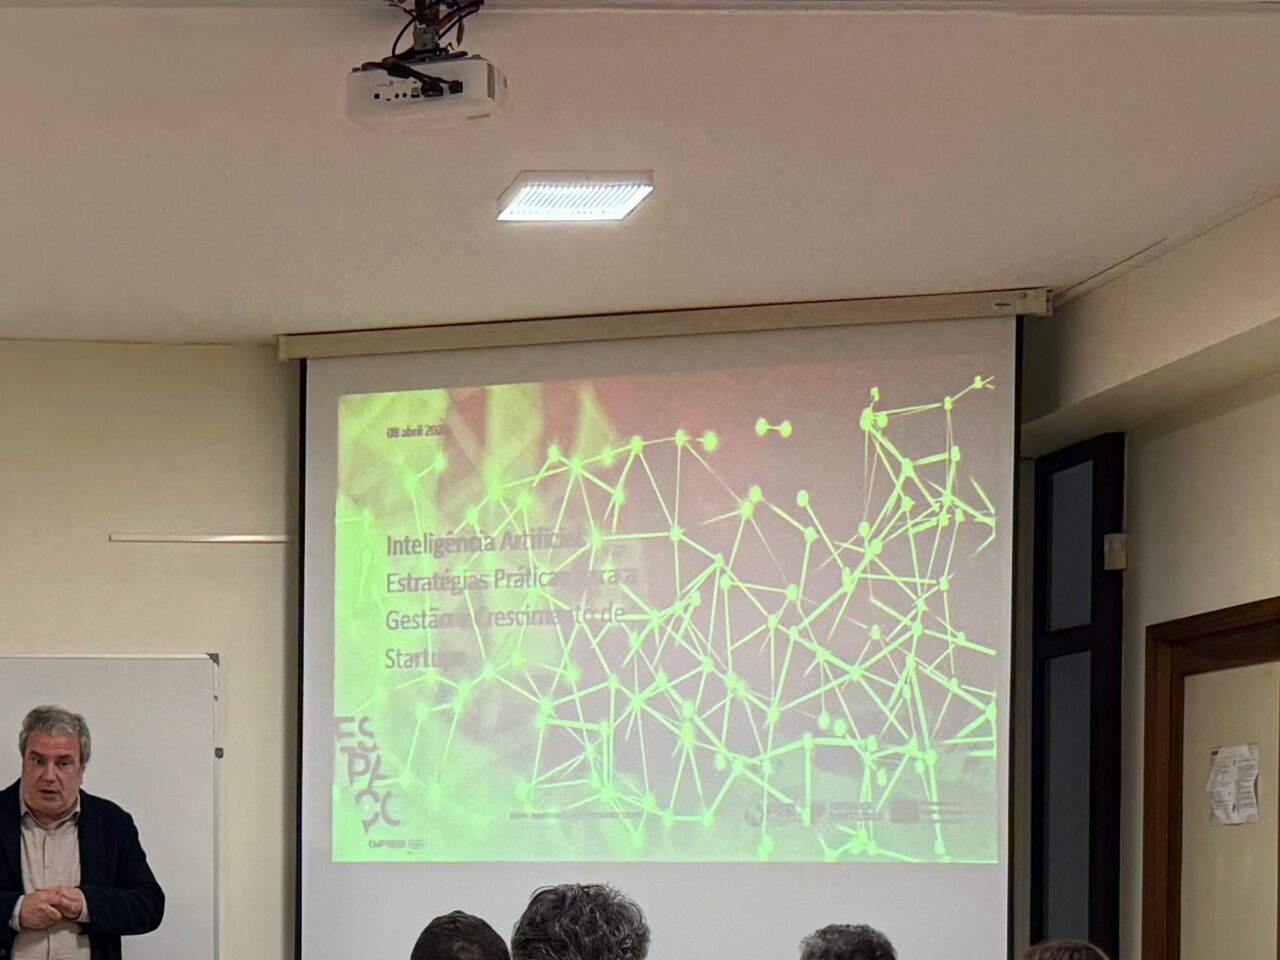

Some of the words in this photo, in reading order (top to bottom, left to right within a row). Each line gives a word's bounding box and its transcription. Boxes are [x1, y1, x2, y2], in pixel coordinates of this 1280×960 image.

[401, 424, 423, 438] abril
[386, 530, 496, 559] Inteligência
[499, 525, 583, 551] Artificl
[386, 568, 489, 595] Estratégias
[493, 565, 566, 589] Prática
[385, 606, 454, 631] Gestão
[475, 605, 596, 628] Crescimto
[601, 601, 626, 624] de
